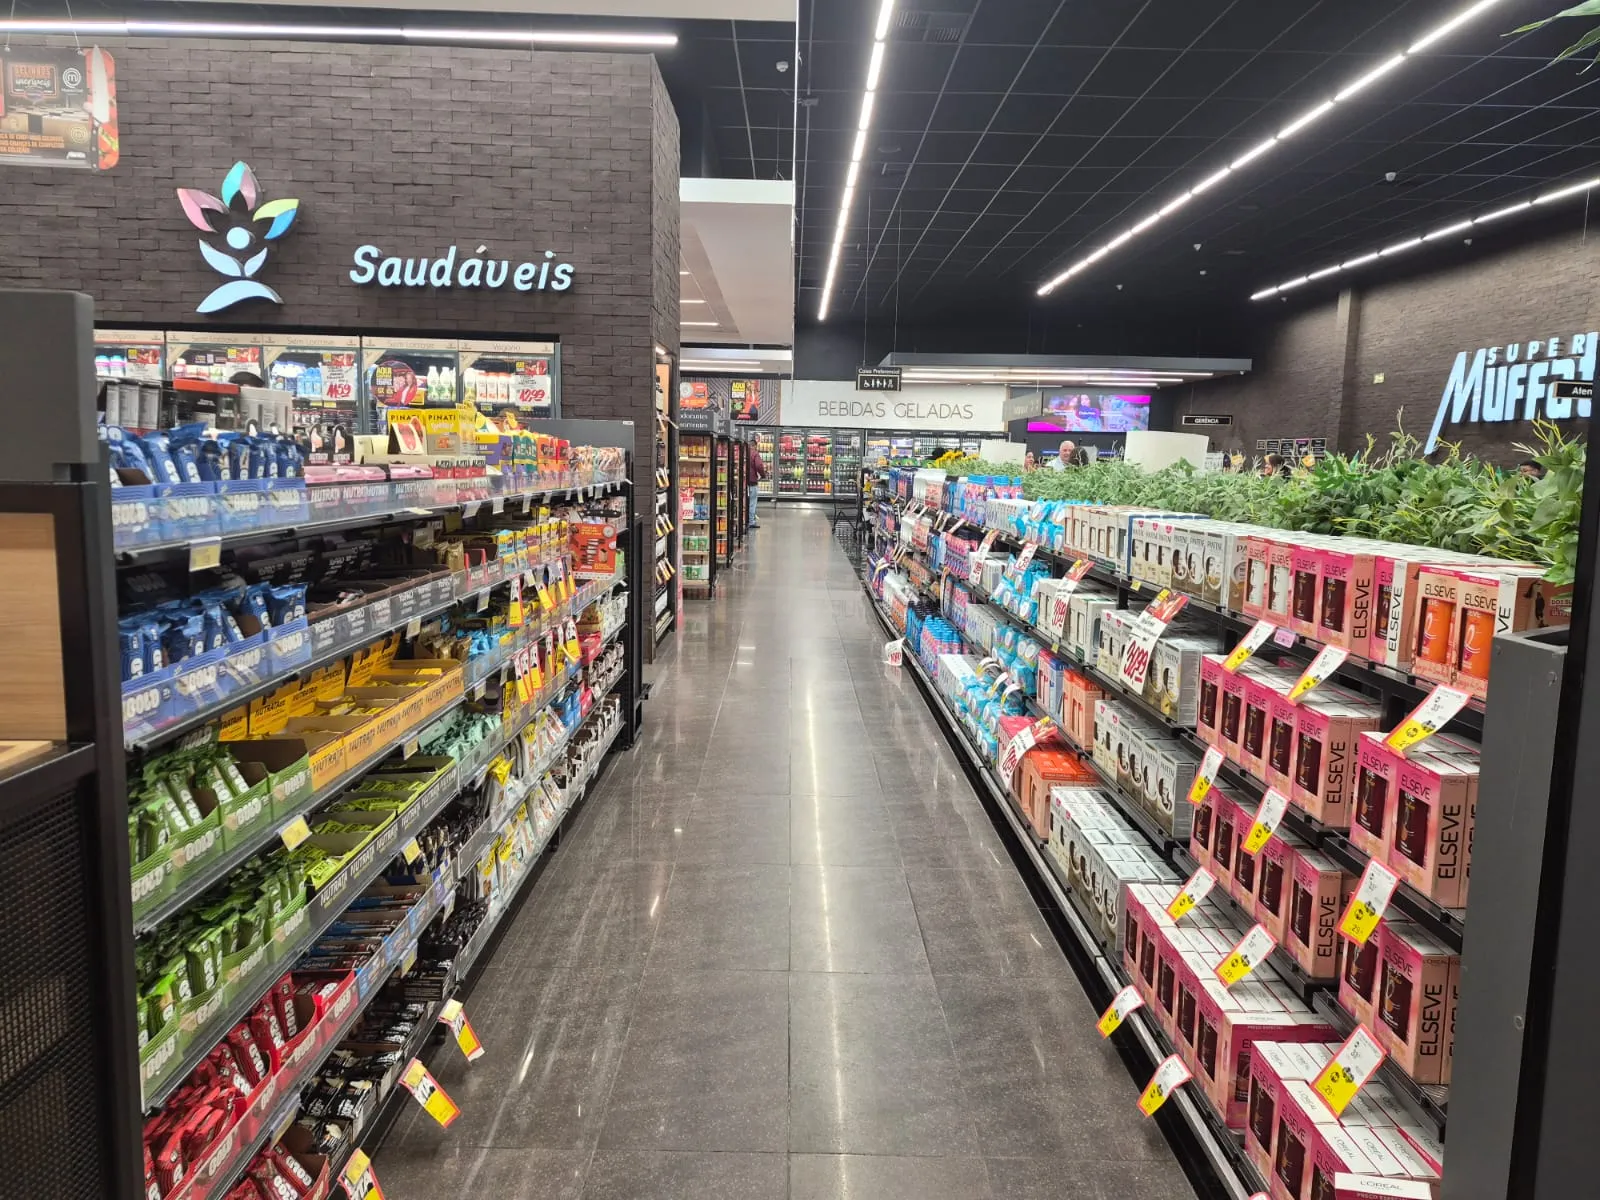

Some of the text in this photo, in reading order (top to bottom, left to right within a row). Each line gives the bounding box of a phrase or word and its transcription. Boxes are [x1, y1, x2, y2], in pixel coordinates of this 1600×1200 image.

[349, 243, 575, 292] Saudáveis
[1486, 333, 1587, 366] SUPER
[818, 400, 974, 420] BEBIDAS GELADAS
[1296, 558, 1317, 572] ELSEVE
[1324, 563, 1347, 578] ELSEVE
[1424, 583, 1456, 600] ELSEVE
[1464, 593, 1497, 611] ELSEVE
[1353, 577, 1371, 639] ELSEVE
[1388, 586, 1403, 652] ELSEVE
[1274, 705, 1294, 724] ELSEVE
[1300, 719, 1323, 741] ELSEVE
[1326, 741, 1346, 804] ELSEVE
[1361, 751, 1390, 777] ELSEVE
[1400, 774, 1432, 801] ELSEVE
[1437, 803, 1461, 879] ELSEVE
[1317, 895, 1337, 958] ELSEVE
[1384, 946, 1413, 978] ELSEVE
[1419, 983, 1443, 1057] ELSEVE
[1252, 1062, 1276, 1097] ELSEVE
[1281, 1103, 1307, 1142] ELSEVE
